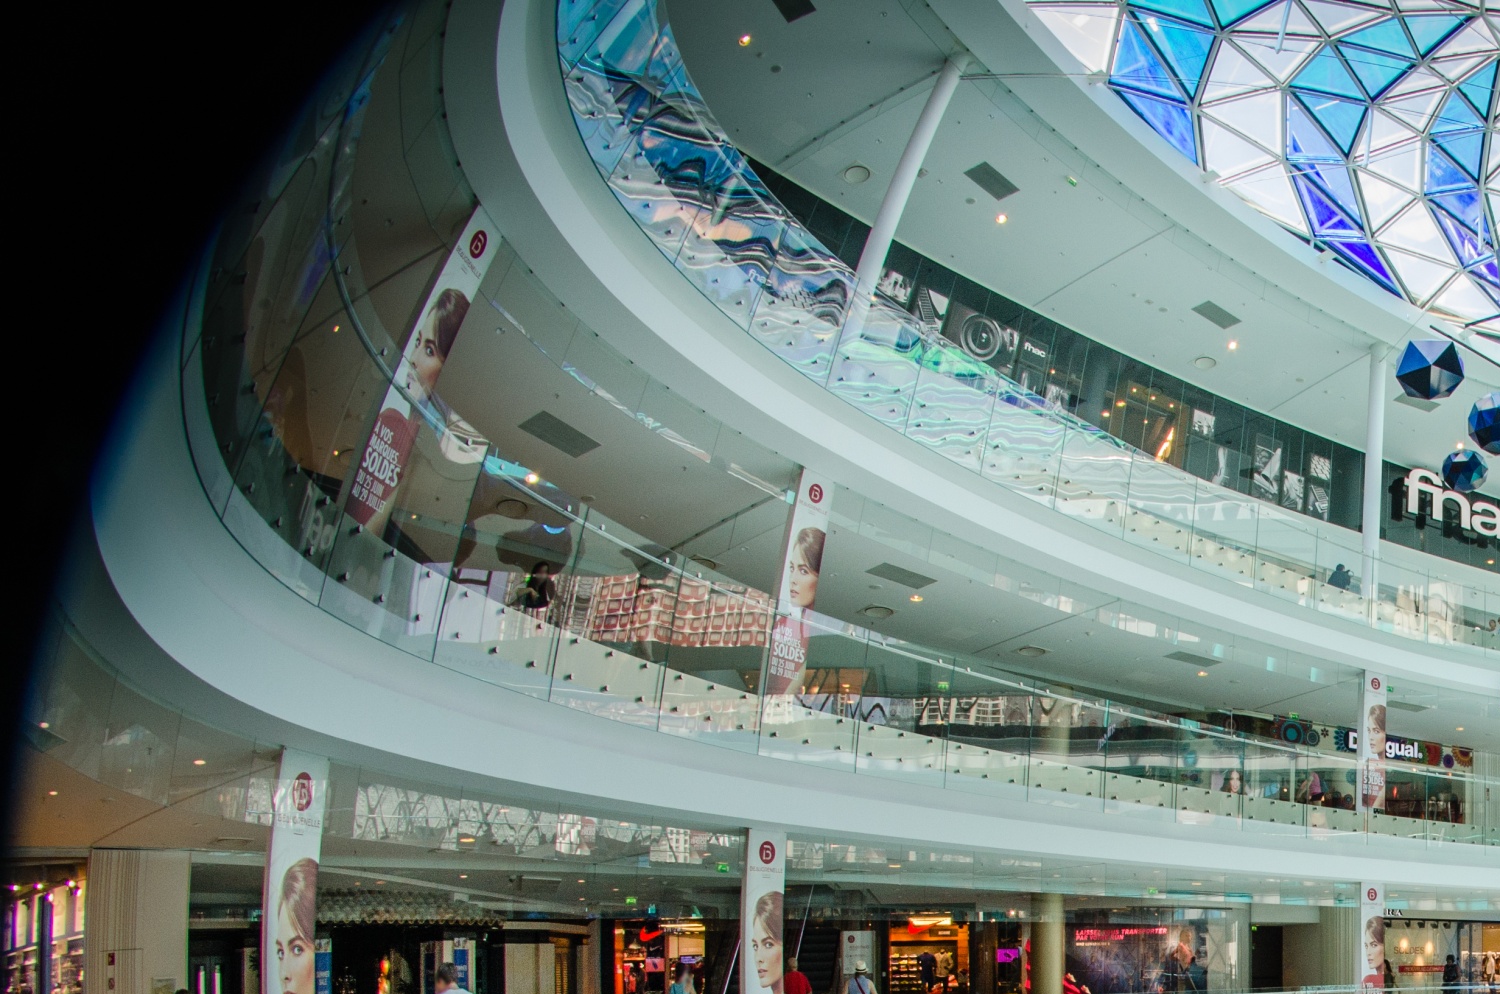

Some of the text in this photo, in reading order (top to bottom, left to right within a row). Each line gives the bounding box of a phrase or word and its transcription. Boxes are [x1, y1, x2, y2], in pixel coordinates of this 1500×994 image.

[456, 245, 482, 280] BEAUGRENELLE
[1024, 341, 1046, 358] fnac
[380, 424, 394, 444] VOS
[362, 446, 401, 488] SOLDES
[356, 468, 384, 497] DU 25 JUIN
[351, 482, 386, 513] AU 29 JUILLET
[773, 641, 805, 663] SOLDES
[771, 656, 796, 671] DU 25 JUIN
[776, 667, 784, 676] 29
[750, 865, 783, 874] BEAUGRENELLE
[1394, 946, 1425, 955] SOLDES
